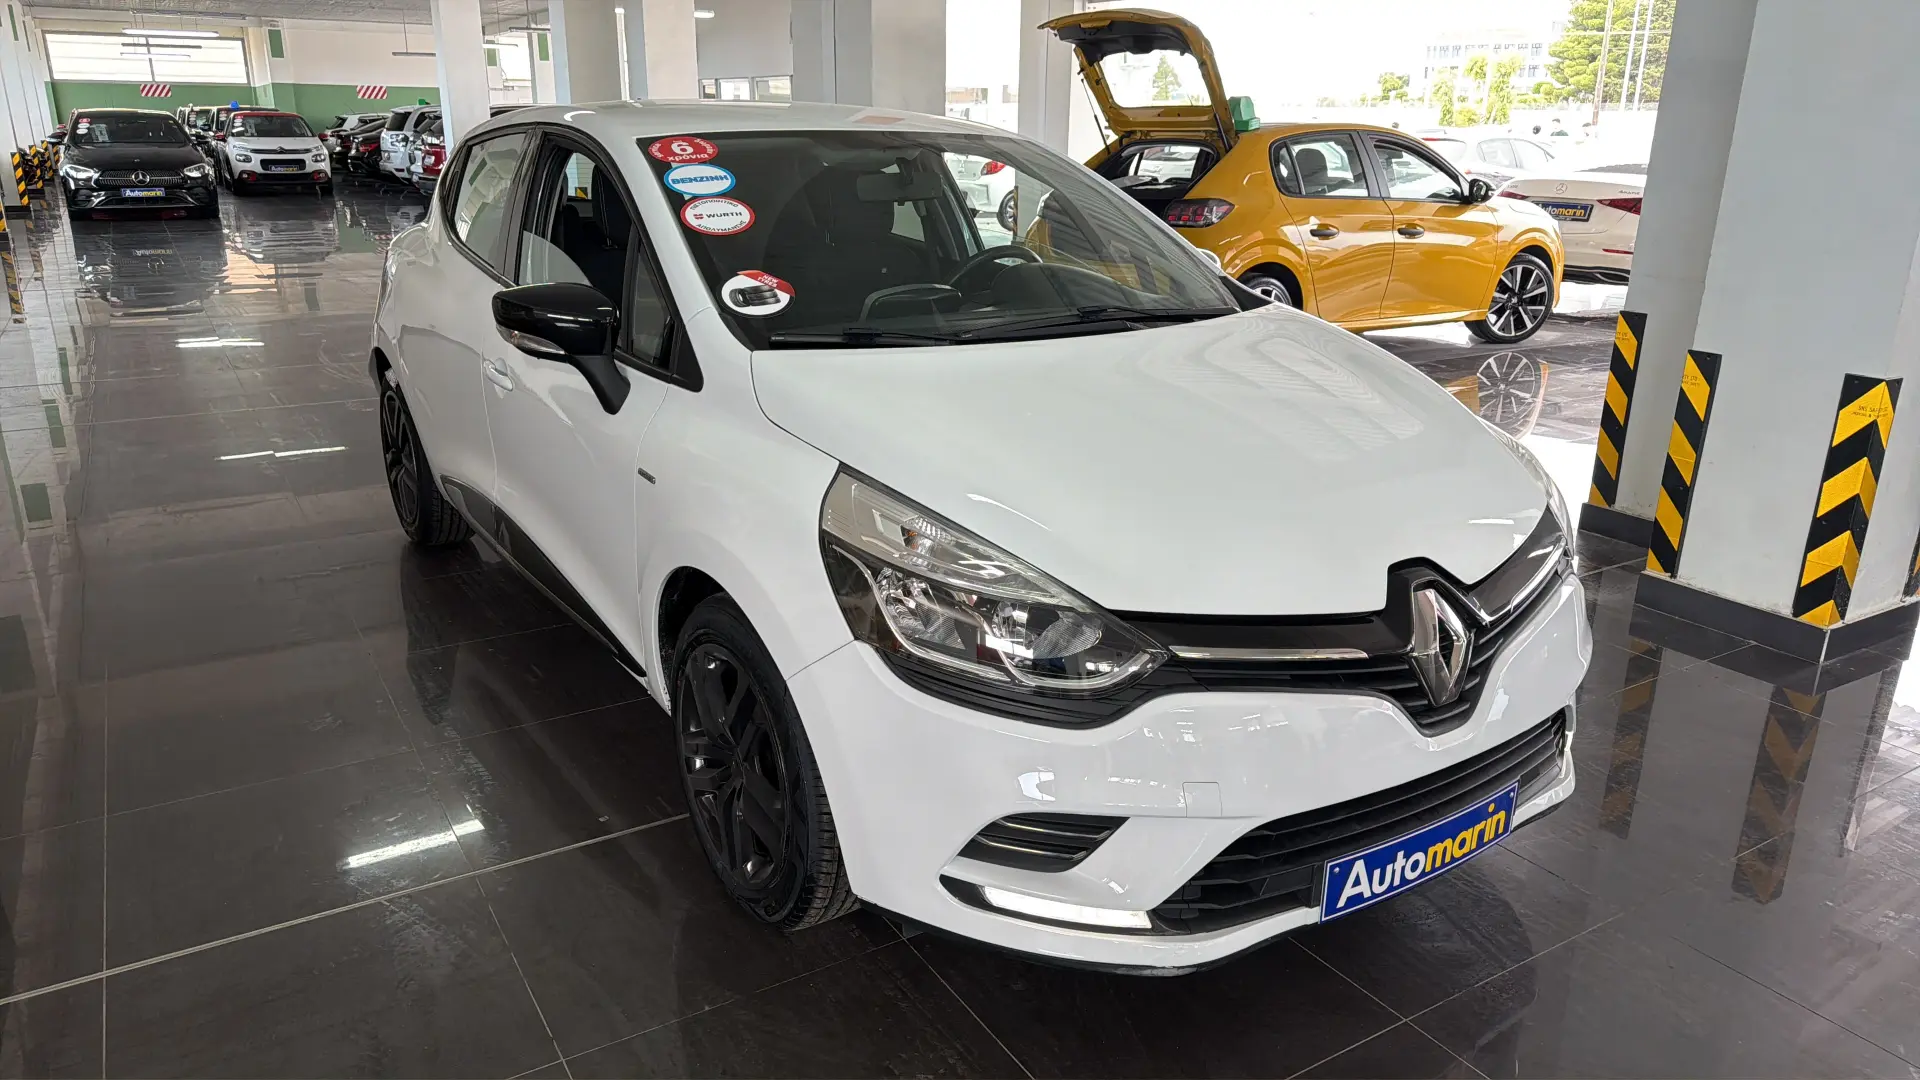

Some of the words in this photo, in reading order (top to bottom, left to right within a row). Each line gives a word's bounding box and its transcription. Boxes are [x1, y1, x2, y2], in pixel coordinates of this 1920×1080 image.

[671, 142, 694, 155] 6
[667, 153, 709, 162] χρόνια
[670, 174, 729, 185] ΒΕΝΖΙΝΗ
[125, 189, 163, 197] Automarin
[1540, 204, 1585, 217] utomarin
[1335, 802, 1506, 909] Automarin
